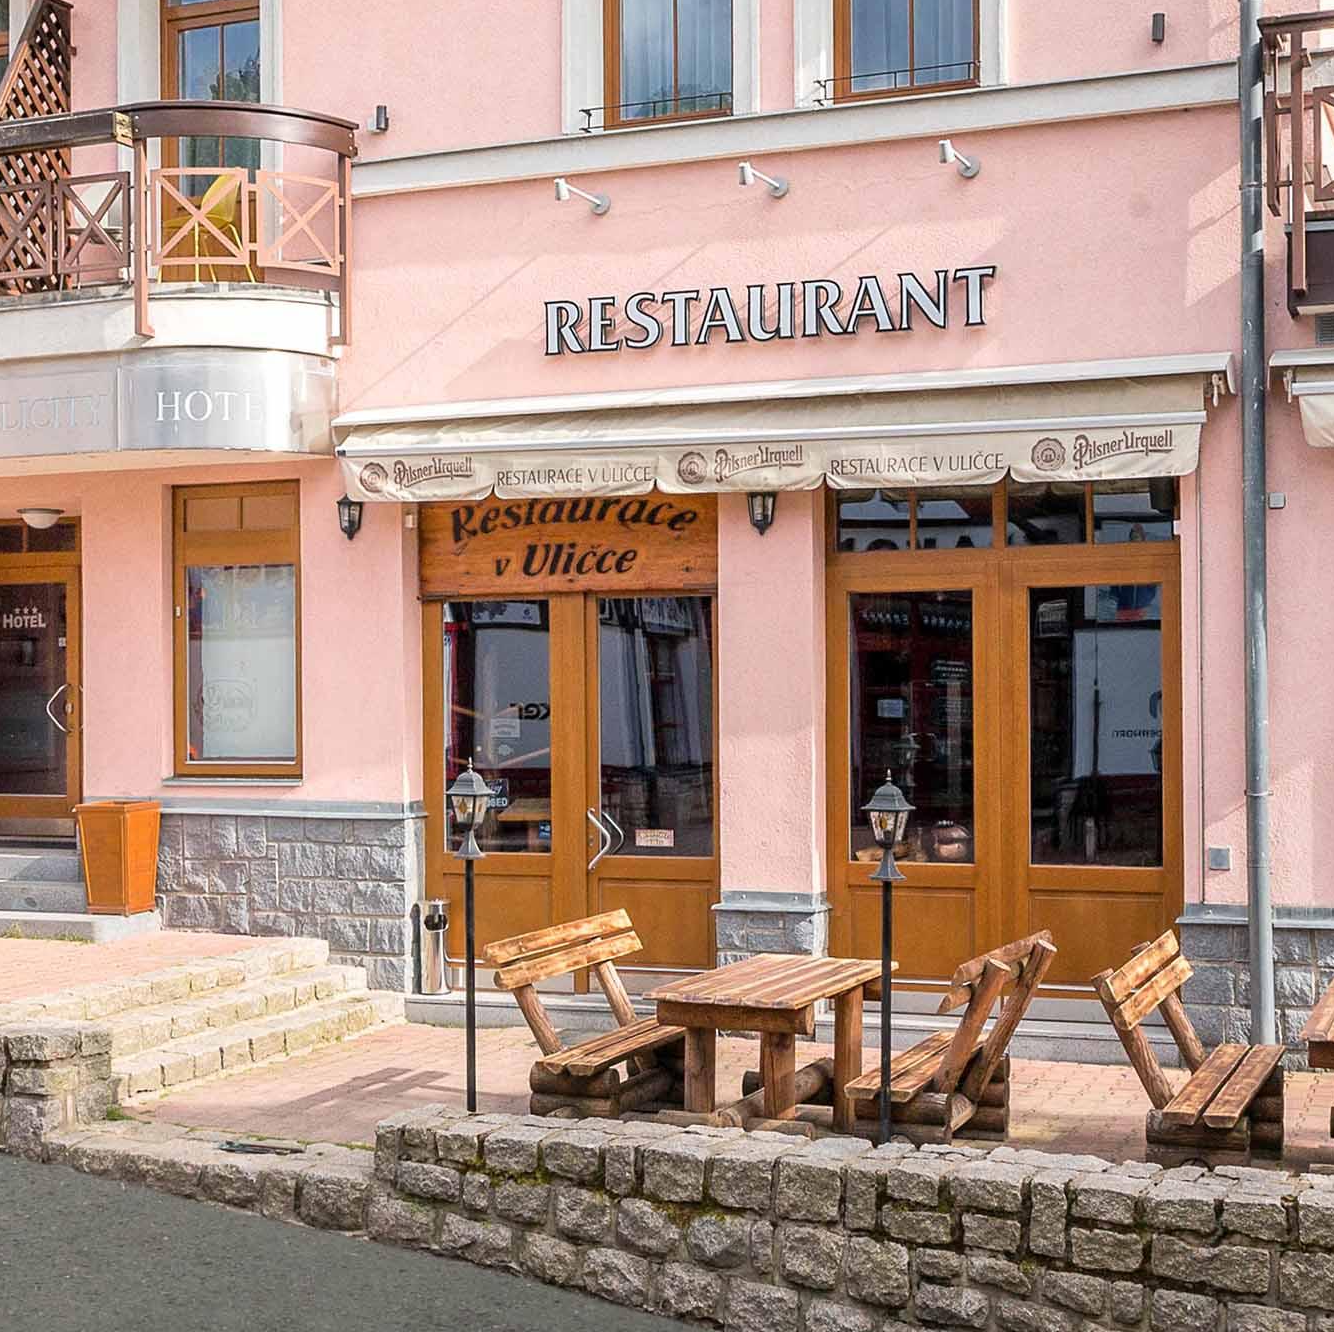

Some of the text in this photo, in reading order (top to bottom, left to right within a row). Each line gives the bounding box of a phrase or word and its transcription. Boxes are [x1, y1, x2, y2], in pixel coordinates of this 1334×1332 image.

[544, 265, 997, 356] RESTAURANT
[155, 390, 265, 421] HOTE
[714, 444, 803, 483] Pilsner Urquell
[830, 450, 1004, 476] RESTAURACE V ULIČCE
[1072, 429, 1173, 469] Pilsner Urquell
[394, 456, 473, 489] Pilsner Urquell
[497, 463, 652, 486] RESTAURACE V ULIČCE
[451, 497, 698, 543] Restaurace
[495, 542, 638, 578] v Uličce
[3, 613, 46, 629] HOTEL
